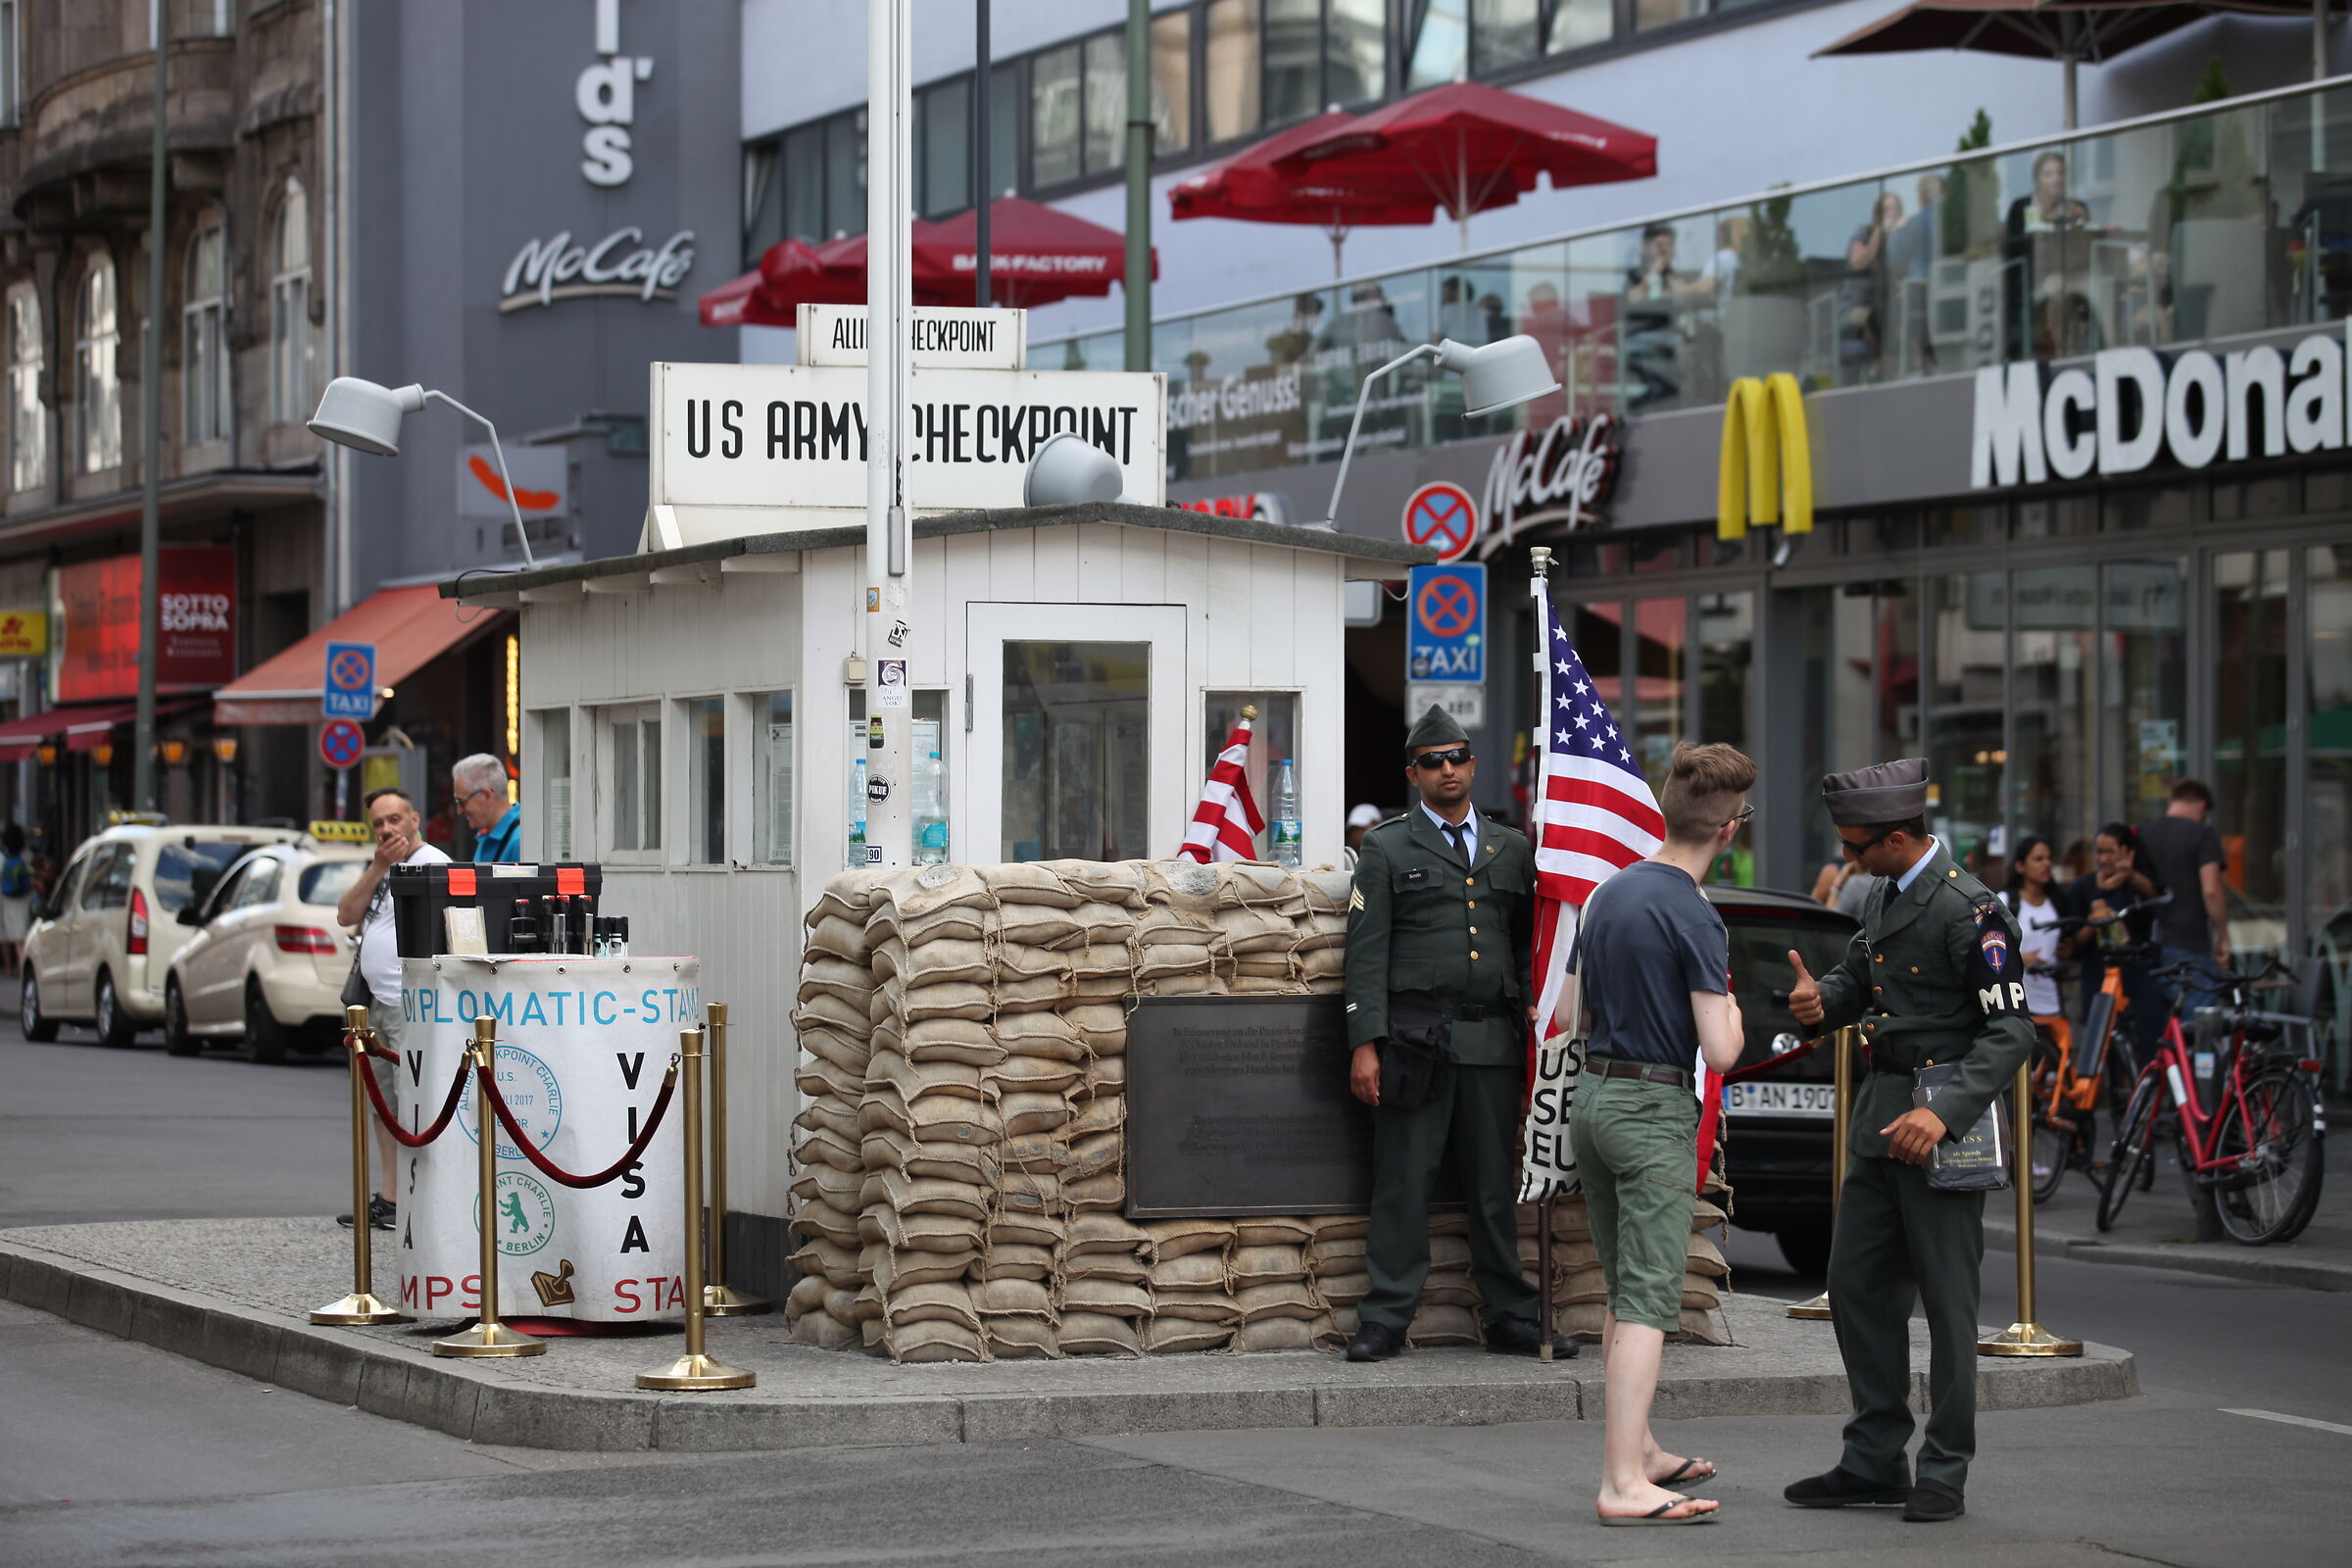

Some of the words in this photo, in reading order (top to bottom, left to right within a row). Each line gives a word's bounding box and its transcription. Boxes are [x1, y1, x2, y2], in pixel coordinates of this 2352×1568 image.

[503, 227, 695, 307] McCafé
[832, 318, 869, 350] ALLI
[911, 319, 997, 352] ECKPOINT
[687, 399, 743, 459] US
[766, 400, 868, 462] ARMY
[1481, 414, 1609, 546] McCafé
[162, 594, 229, 612] SOTTO
[162, 612, 230, 631] SOPRA
[1414, 646, 1478, 673] TAXI
[329, 693, 369, 712] TAXI
[866, 849, 880, 860] 90
[402, 988, 699, 1026] DIPLOMATIC-STAM
[497, 1071, 516, 1082] U.S.
[514, 1095, 534, 1105] 2017
[536, 1065, 559, 1116] CHARLIE
[1731, 1085, 1743, 1106] B
[1760, 1086, 1787, 1108] AN
[496, 1144, 522, 1157] BERL
[616, 1052, 651, 1253] VISA
[517, 1177, 551, 1218] CHARLIE
[506, 1232, 546, 1251] BERLIN
[613, 1276, 686, 1314] STA
